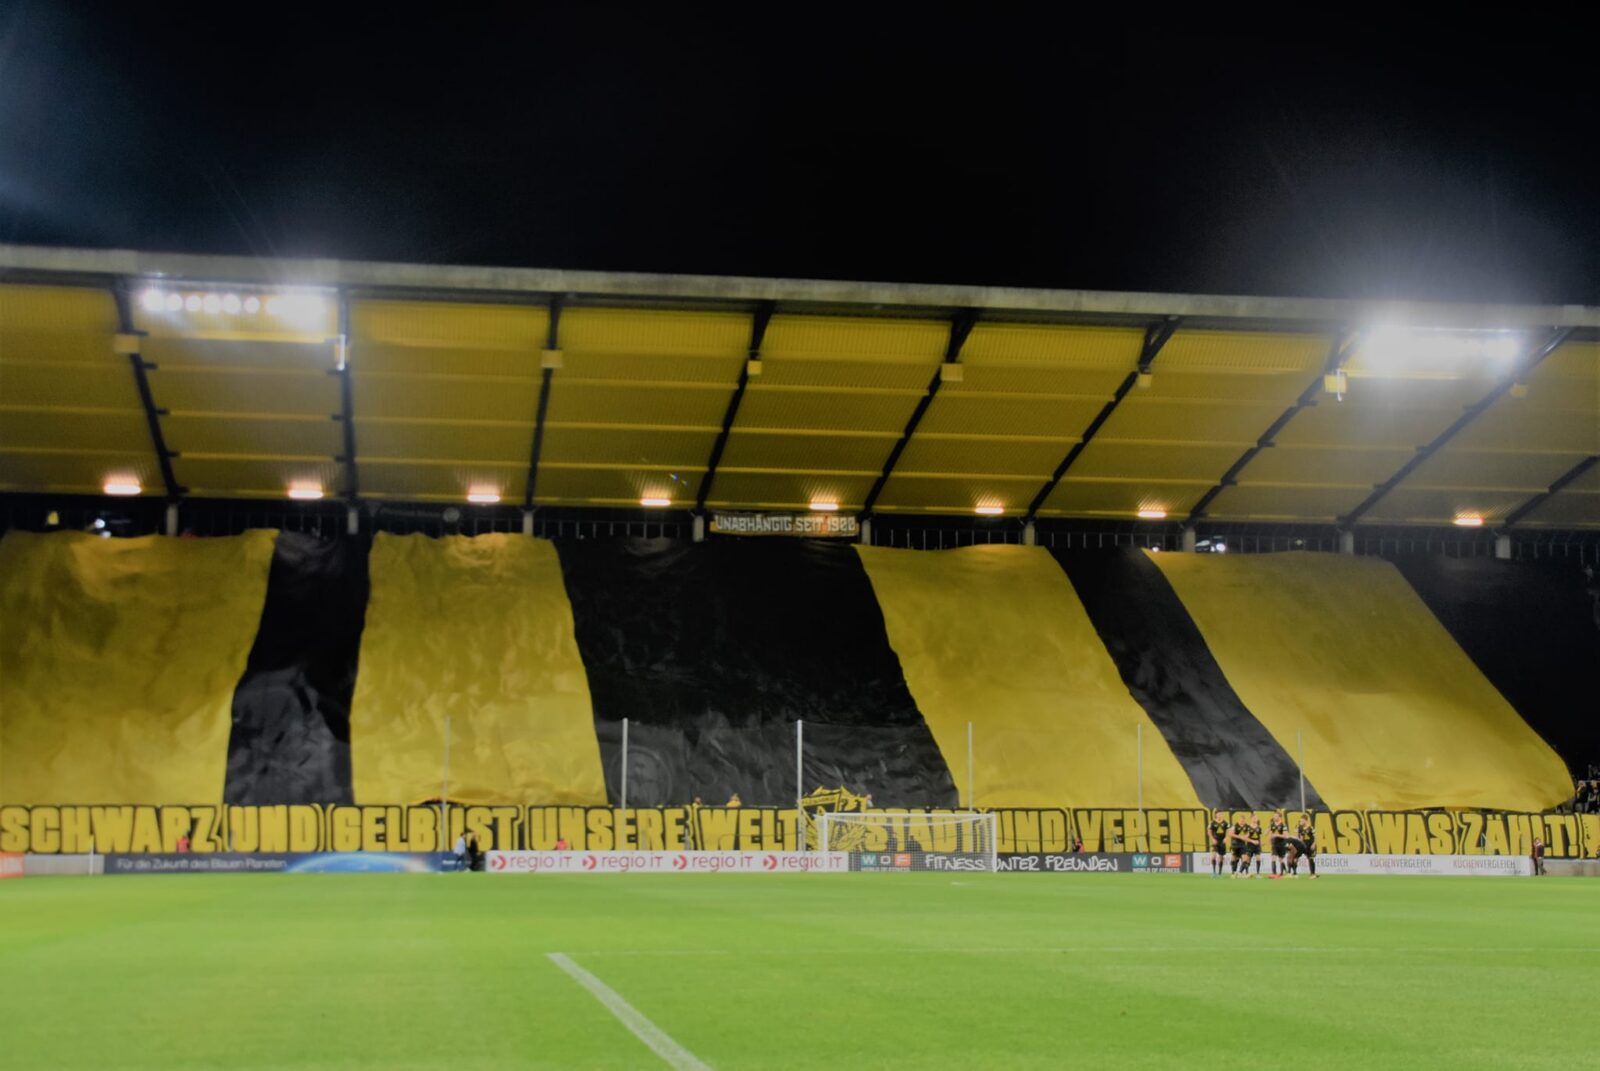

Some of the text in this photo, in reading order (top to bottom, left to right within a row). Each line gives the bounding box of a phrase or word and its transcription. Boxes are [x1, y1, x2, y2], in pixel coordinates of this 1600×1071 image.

[715, 514, 792, 532] UNABHÄNGIG
[795, 517, 823, 532] SEIT
[0, 805, 799, 853] SCHWARZ UND GELB IST UNSERE WELT
[865, 808, 978, 852] STADT
[991, 809, 1066, 852] UND
[1076, 809, 1207, 852] VEREIN
[1369, 812, 1453, 854] WAS
[1462, 813, 1578, 857] ZÄHLT!
[151, 858, 189, 869] Zukunft
[245, 858, 288, 869] Planeten
[510, 854, 554, 872] regio
[601, 854, 645, 872] regio
[692, 854, 736, 872] regio
[782, 854, 824, 872] regio
[925, 855, 985, 871] FITNESS
[1045, 855, 1118, 872] FREUNDEN
